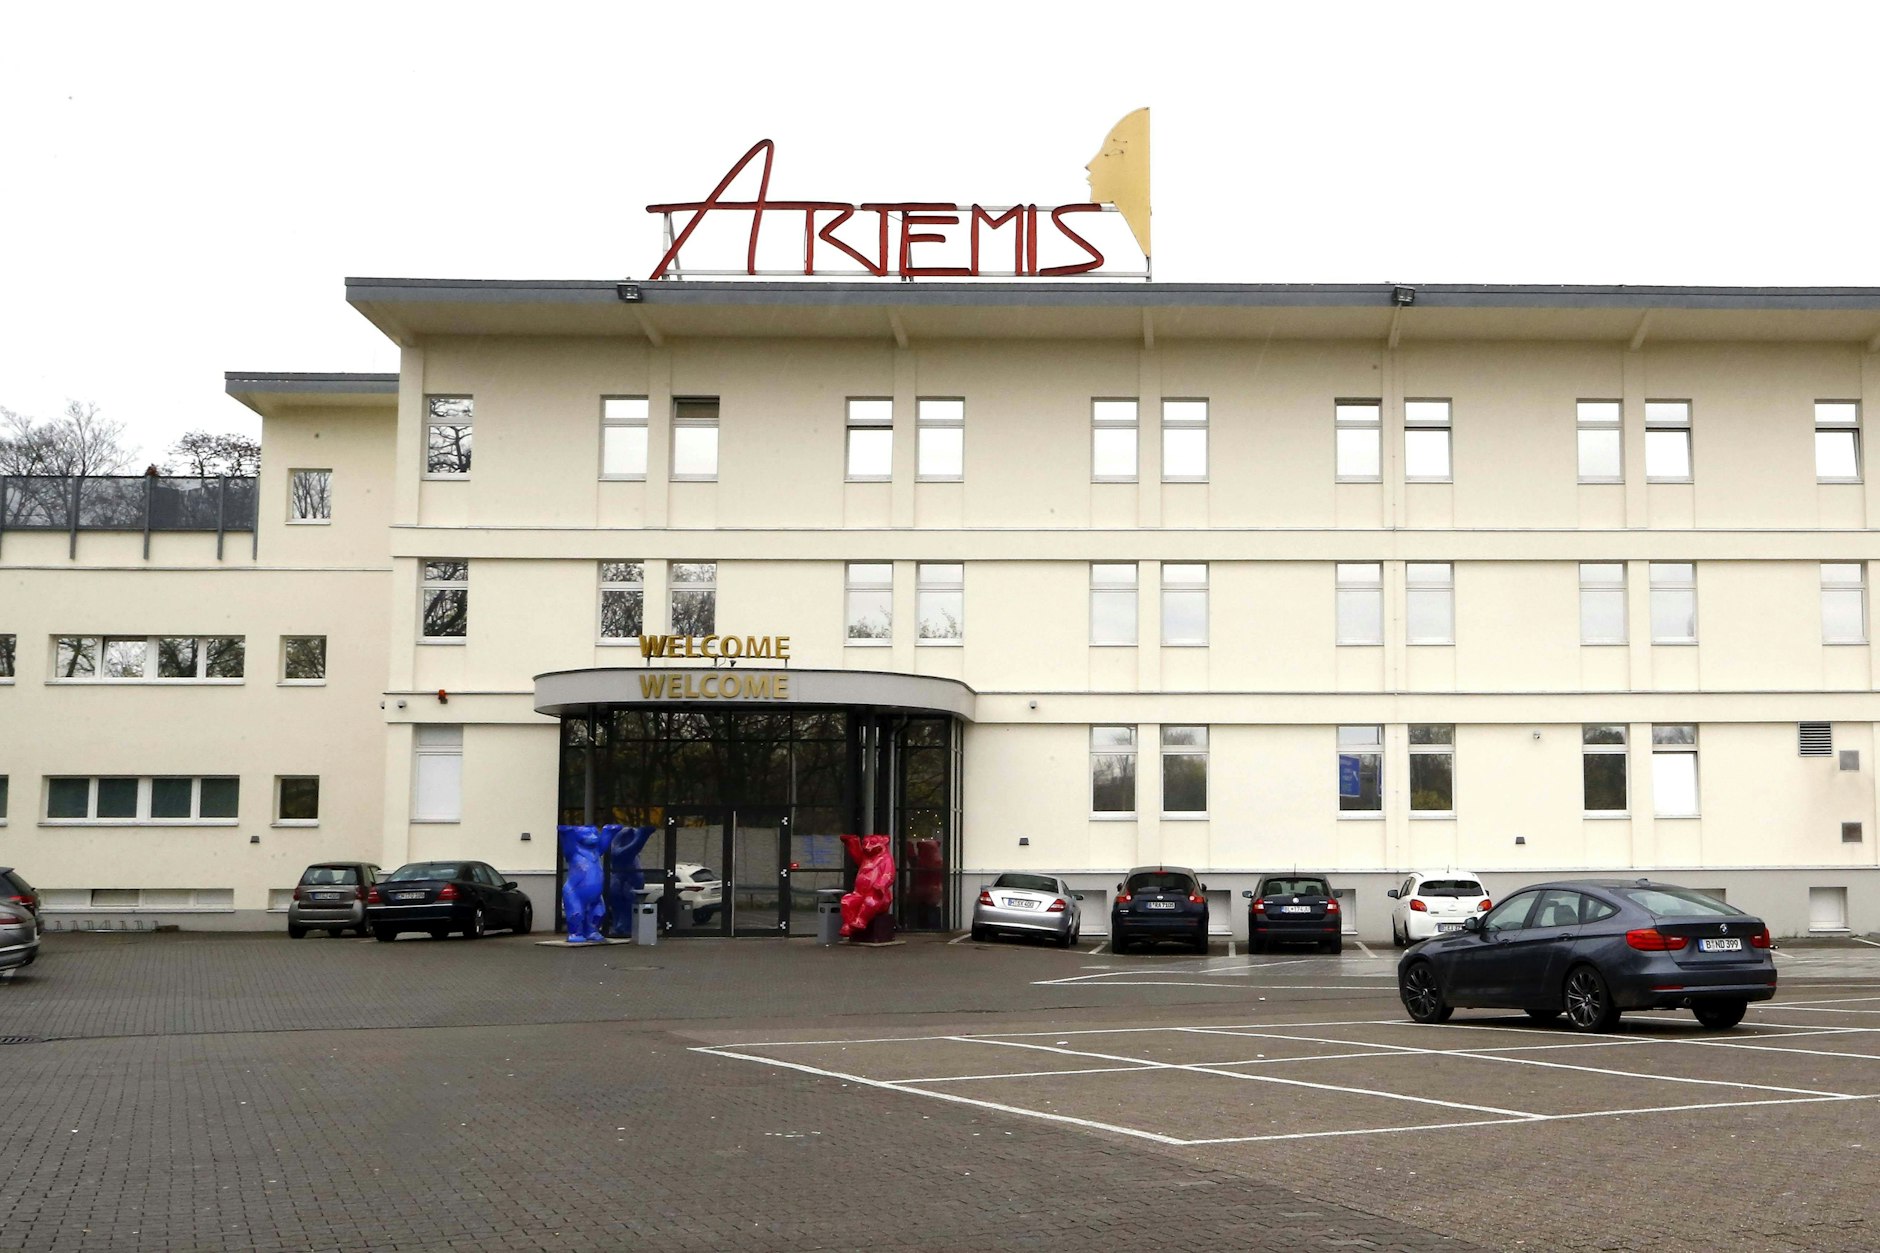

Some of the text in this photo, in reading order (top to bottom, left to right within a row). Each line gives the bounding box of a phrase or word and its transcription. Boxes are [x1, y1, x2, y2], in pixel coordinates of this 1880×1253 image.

[645, 138, 1104, 279] ARTEMIS
[639, 634, 790, 659] WELCOME
[639, 674, 789, 699] WELCOME
[1715, 940, 1725, 949] ND
[1726, 939, 1739, 948] 399
